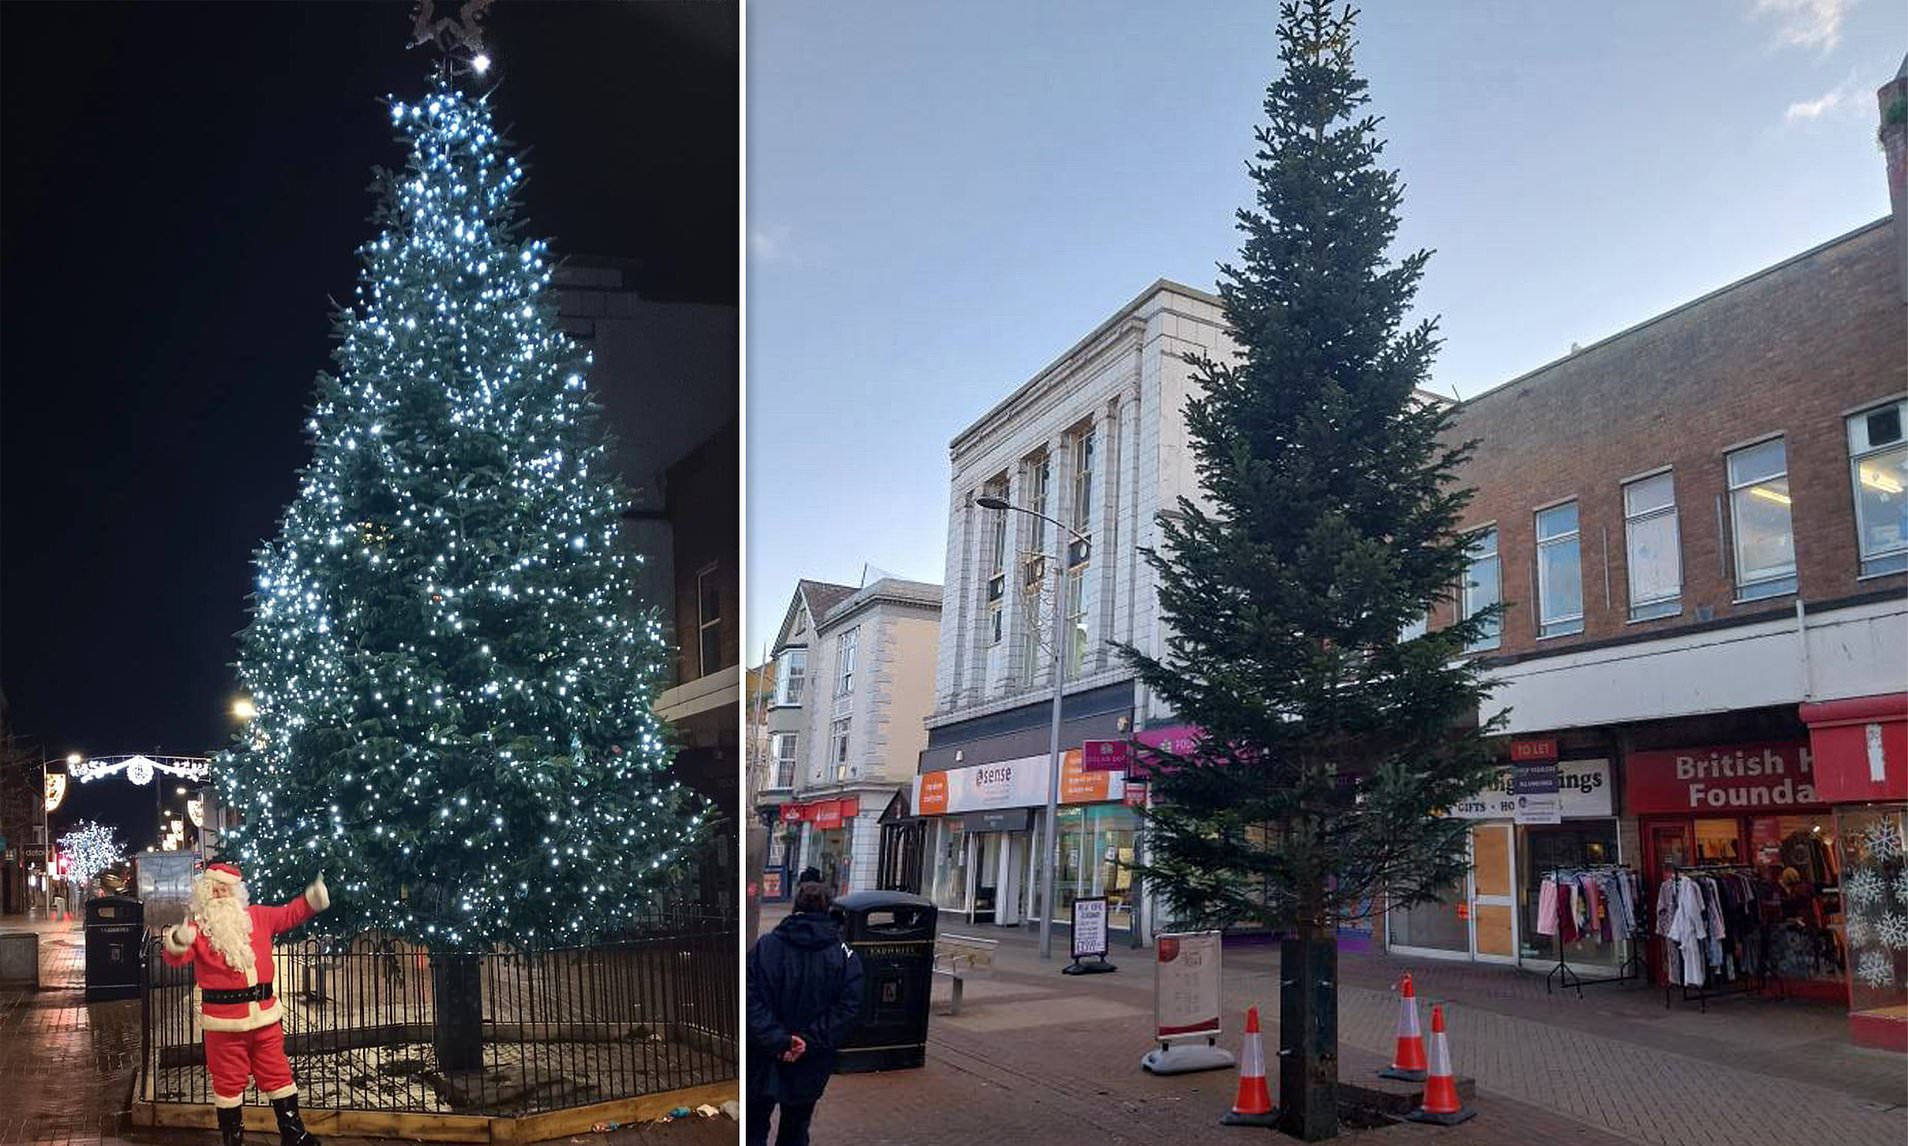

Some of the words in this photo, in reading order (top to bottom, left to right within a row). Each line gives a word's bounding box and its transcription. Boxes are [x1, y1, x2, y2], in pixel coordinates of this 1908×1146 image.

[1533, 743, 1549, 755] LET
[1676, 749, 1784, 780] British
[1800, 747, 1813, 772] H
[1559, 770, 1603, 794] ings
[1688, 778, 1816, 807] Founda
[1458, 802, 1486, 812] GIFTS
